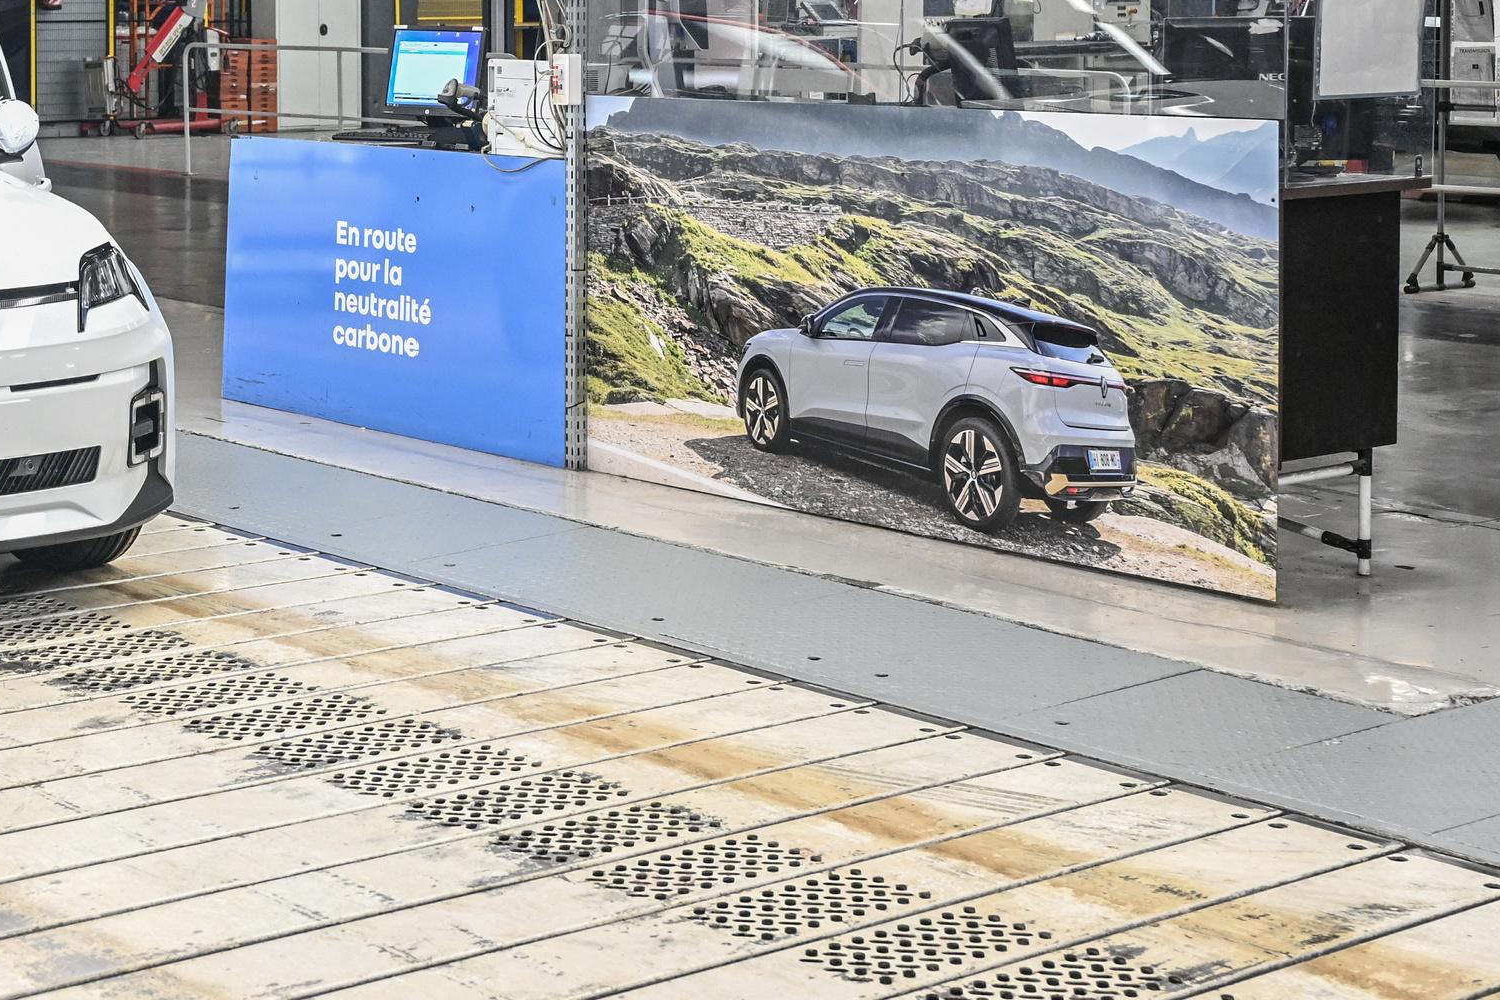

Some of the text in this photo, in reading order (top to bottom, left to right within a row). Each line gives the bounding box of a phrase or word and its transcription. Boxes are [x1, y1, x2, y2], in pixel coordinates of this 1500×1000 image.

[336, 220, 417, 254] En route
[335, 258, 402, 286] pour la
[334, 291, 431, 325] neutralité
[333, 324, 420, 357] carbone
